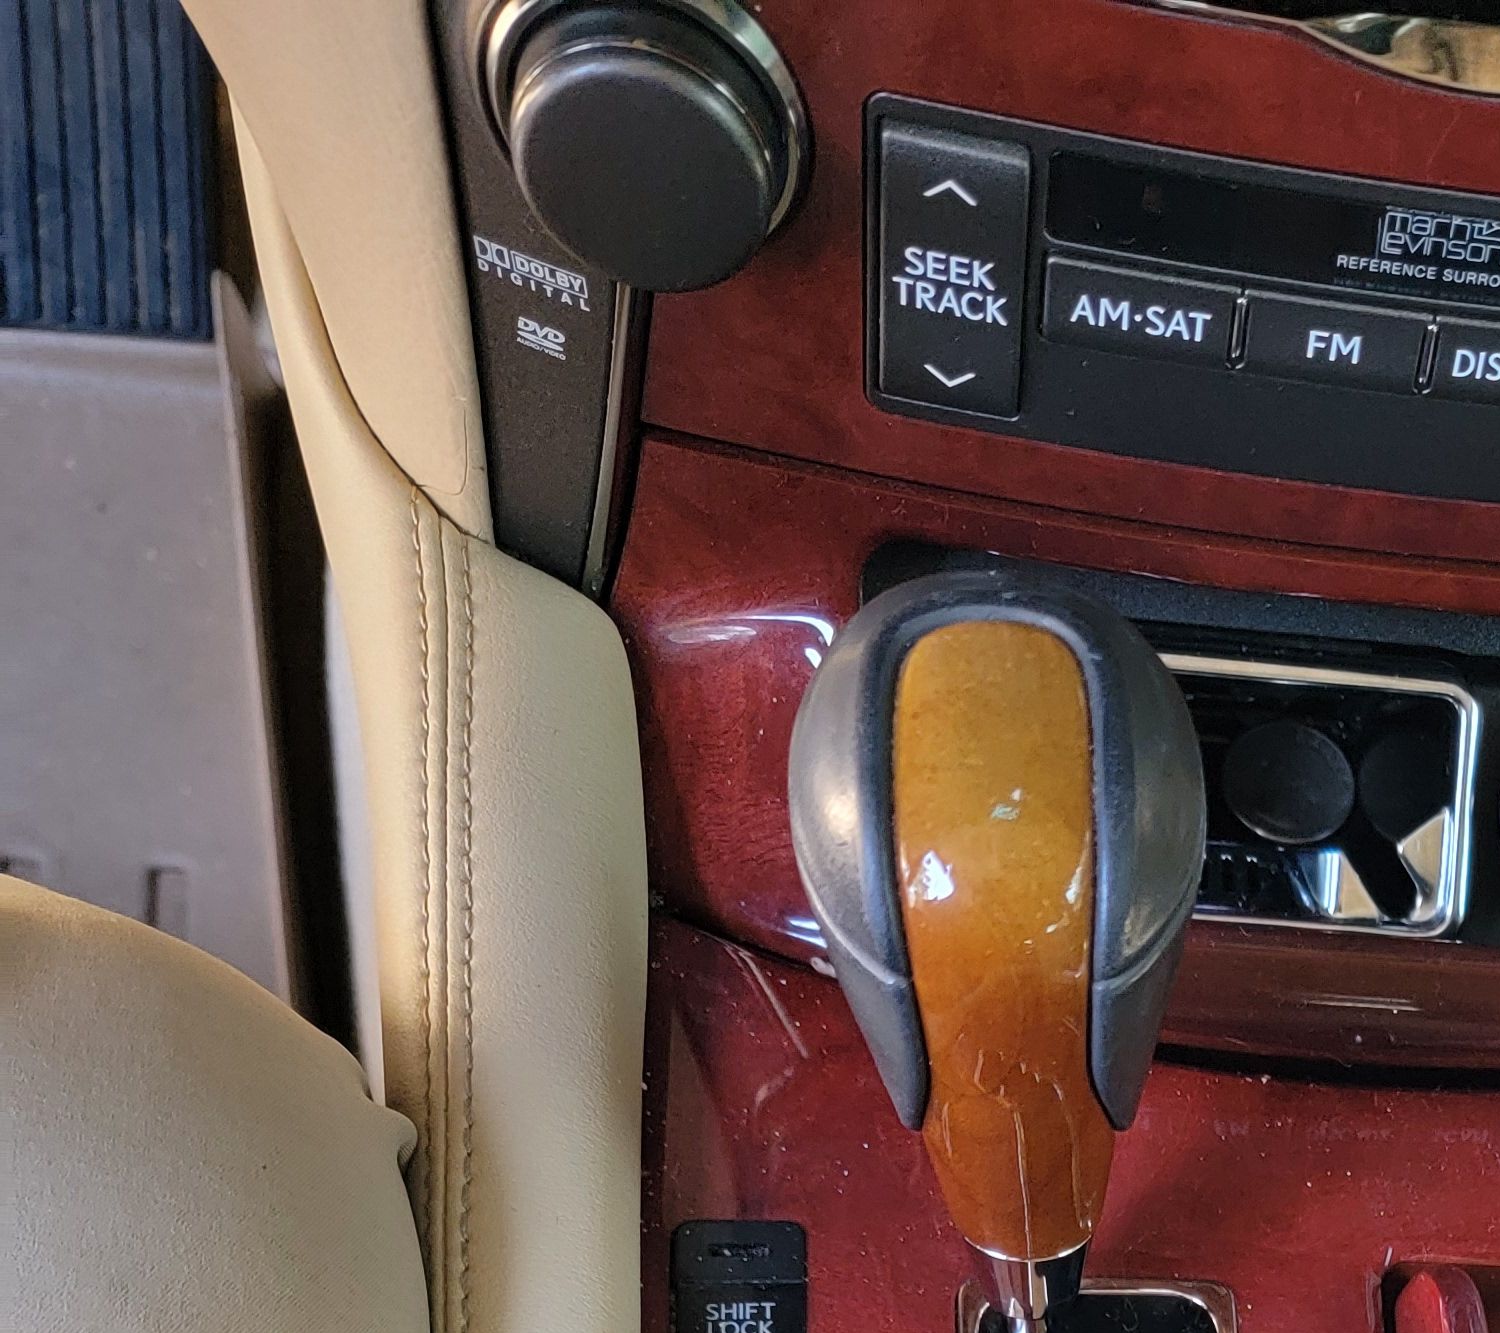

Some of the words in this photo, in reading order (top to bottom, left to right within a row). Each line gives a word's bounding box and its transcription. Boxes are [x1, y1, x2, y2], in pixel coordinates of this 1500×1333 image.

[513, 256, 582, 292] DOLBY
[903, 246, 995, 290] SEEK
[1337, 254, 1438, 280] REFERENCE
[477, 258, 590, 312] DIGITAL
[892, 277, 1008, 326] TRACK
[517, 316, 566, 344] DVD
[1306, 330, 1363, 365] FM
[705, 1302, 776, 1321] SHIFT
